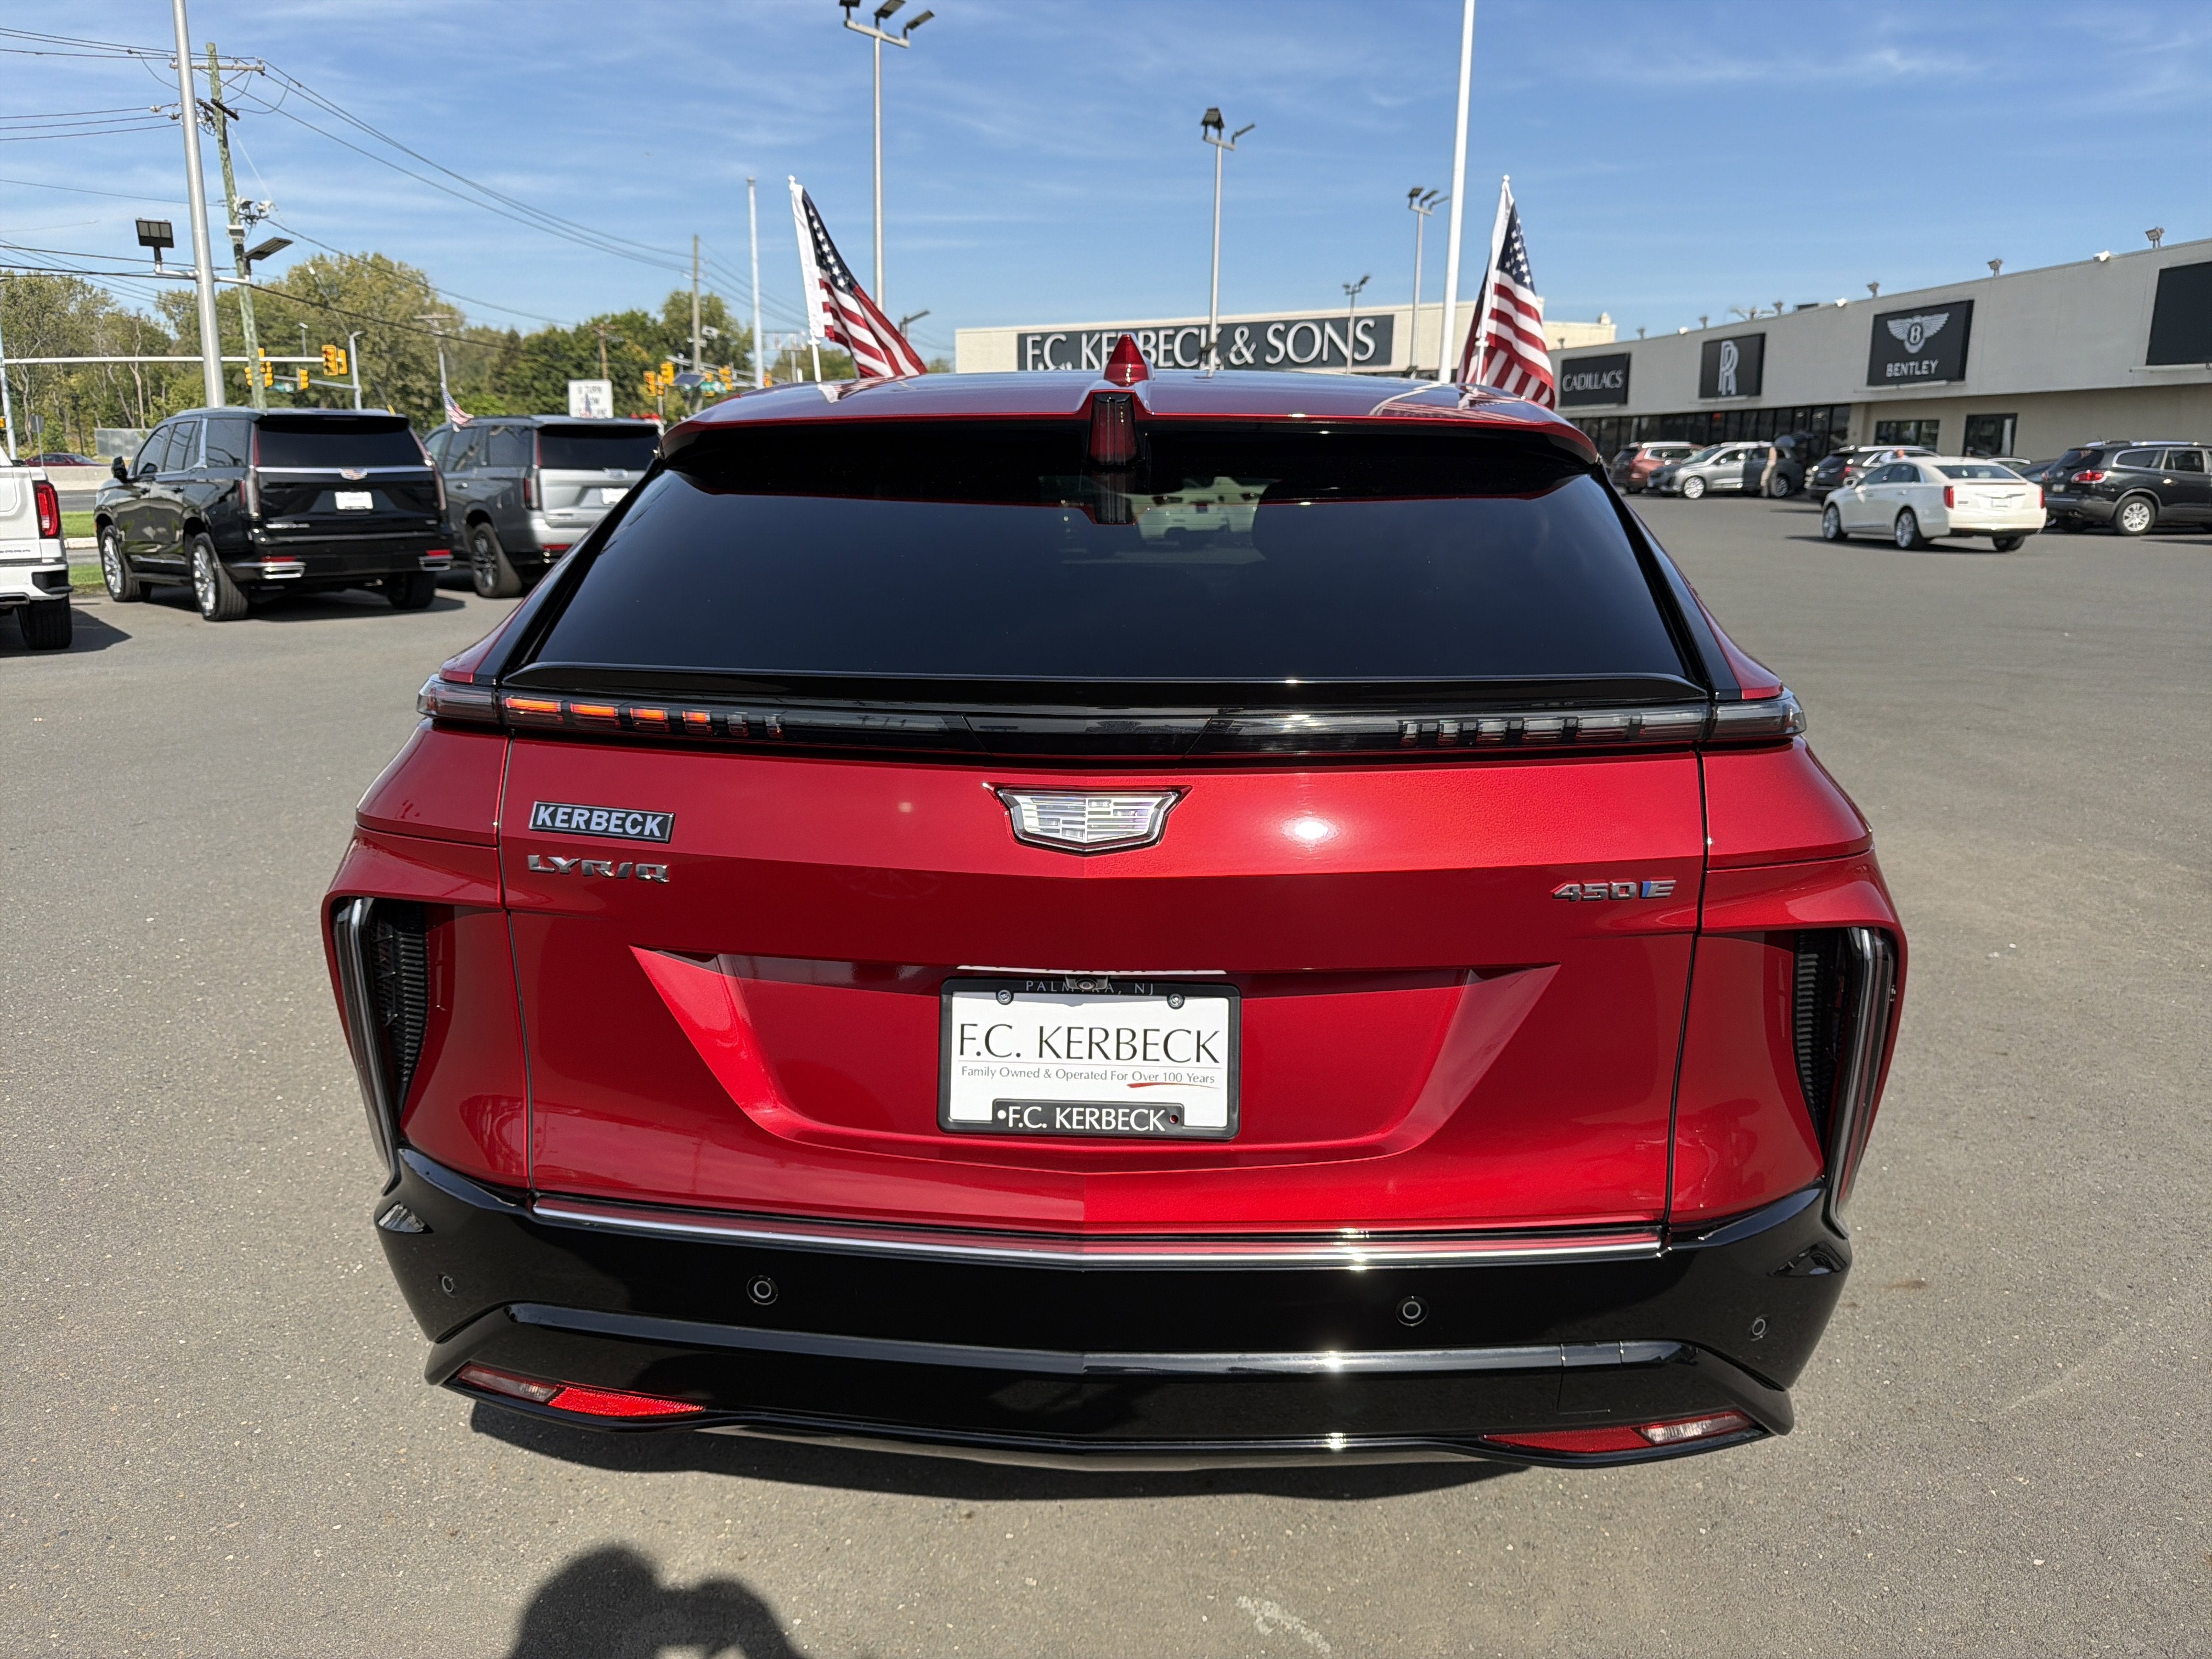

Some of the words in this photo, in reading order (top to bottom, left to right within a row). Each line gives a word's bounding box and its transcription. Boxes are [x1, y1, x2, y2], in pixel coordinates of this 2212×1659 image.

[1026, 333, 1073, 371] F.C.
[1081, 326, 1222, 371] KEBECK
[1229, 325, 1257, 365] &
[1265, 318, 1375, 364] SONS
[1562, 369, 1624, 392] CADILLACS
[1886, 359, 1939, 377] BENTLEY
[535, 805, 664, 837] KERBECK
[527, 854, 670, 883] LYRIQ
[1135, 983, 1154, 996] NJ
[960, 1023, 1022, 1058] F.C.
[1039, 1025, 1221, 1064] KERBECK
[961, 1066, 997, 1080] Family
[999, 1067, 1040, 1079] Owned
[1043, 1069, 1052, 1079] &
[1055, 1068, 1107, 1082] Operated
[1110, 1070, 1128, 1081] For
[1132, 1071, 1159, 1081] Over
[1163, 1072, 1183, 1082] 100
[1186, 1073, 1215, 1084] Years
[1008, 1106, 1047, 1128] F.C.
[1055, 1107, 1166, 1132] KERBECK
